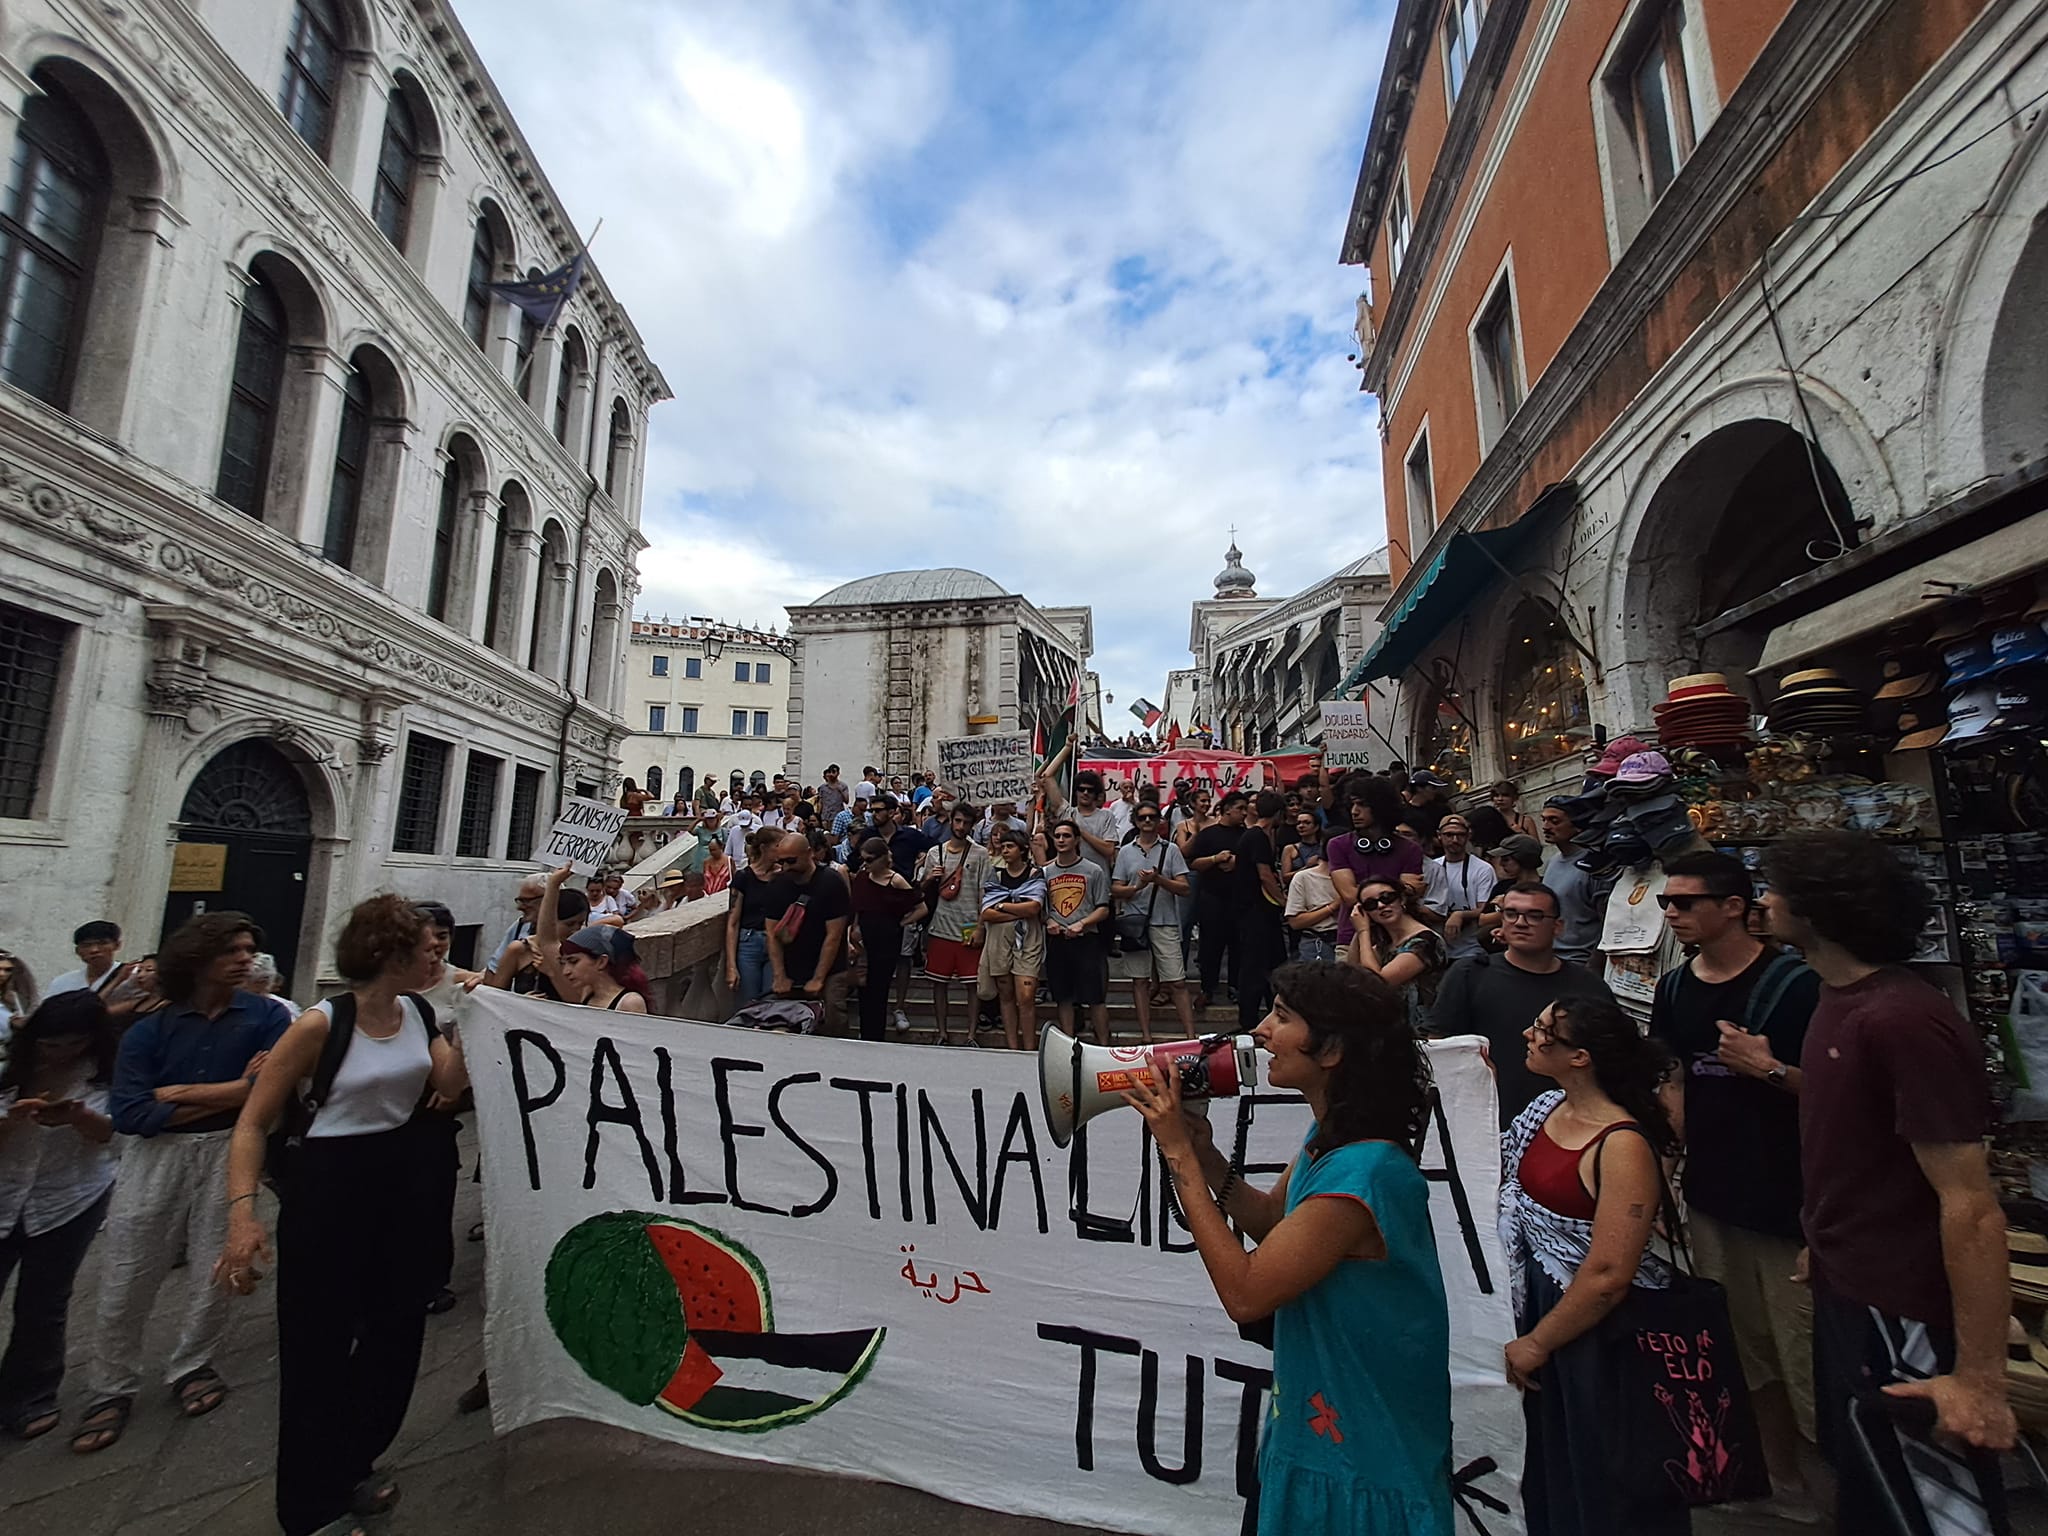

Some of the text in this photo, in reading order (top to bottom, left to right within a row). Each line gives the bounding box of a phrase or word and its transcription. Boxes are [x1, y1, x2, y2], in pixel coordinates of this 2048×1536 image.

[1580, 511, 1609, 544] ORESI
[1321, 728, 1369, 740] STANDARDS
[1325, 714, 1363, 726] DOUBLE
[940, 738, 1029, 761] NESSUNA PACE
[1326, 751, 1369, 766] HUMANS
[944, 757, 1018, 781] PER CHI VIVE
[1173, 766, 1253, 798] complici
[958, 779, 1029, 801] DI GUERRA
[560, 802, 625, 834] ZIONISM IS
[546, 830, 609, 867] TERRORISM
[504, 1029, 1494, 1295] PALESTINA LIEA
[901, 1244, 991, 1304] حرية
